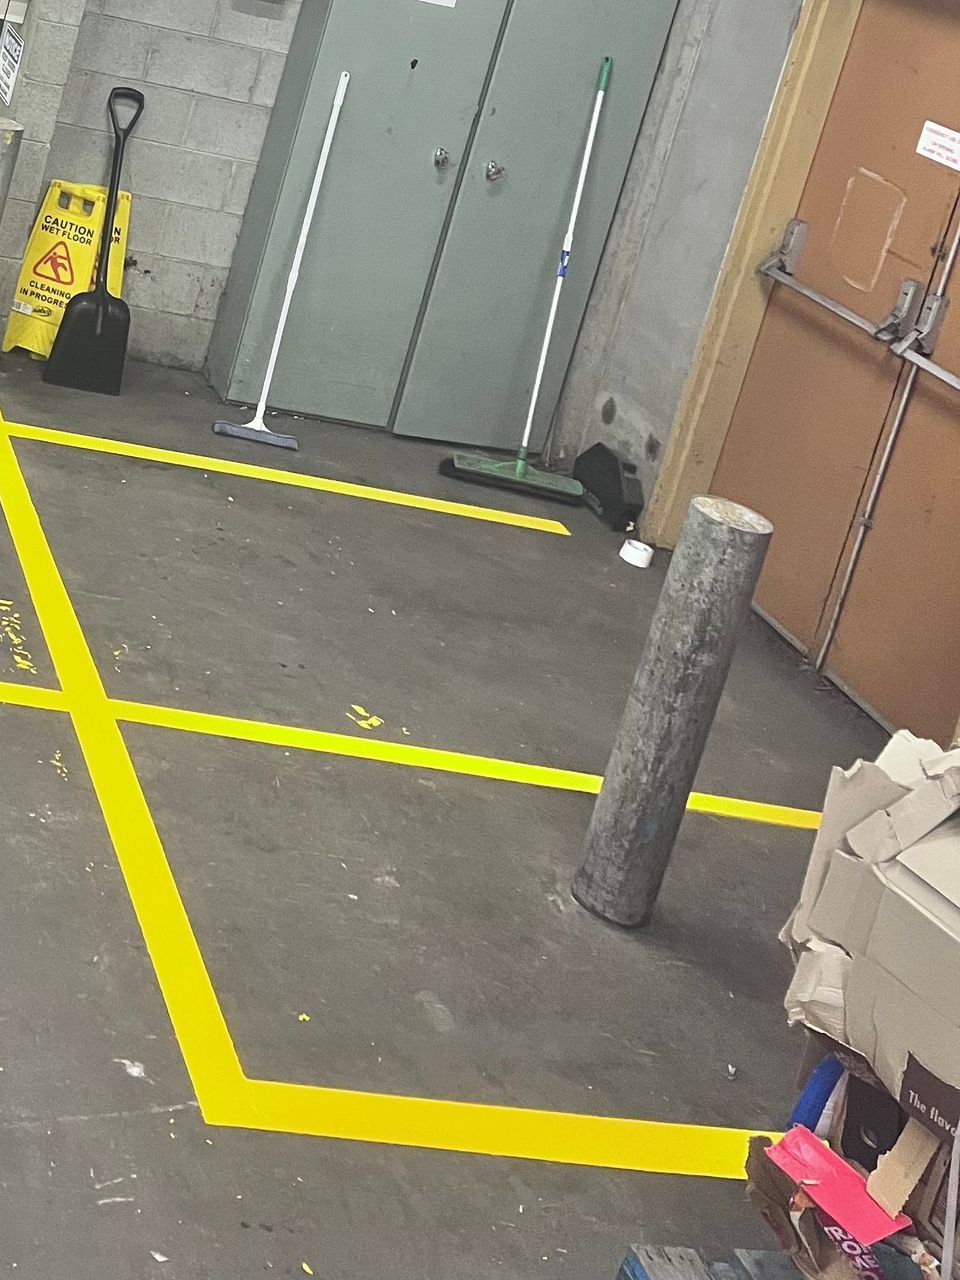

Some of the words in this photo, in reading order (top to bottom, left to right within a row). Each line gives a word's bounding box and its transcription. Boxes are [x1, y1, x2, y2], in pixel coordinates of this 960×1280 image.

[41, 223, 61, 236] WET
[61, 230, 93, 247] FLOOR
[44, 215, 94, 238] CAUTION
[19, 287, 29, 296] IN
[29, 290, 66, 309] PROGRE
[29, 280, 72, 300] CLEANING
[909, 1089, 927, 1113] The
